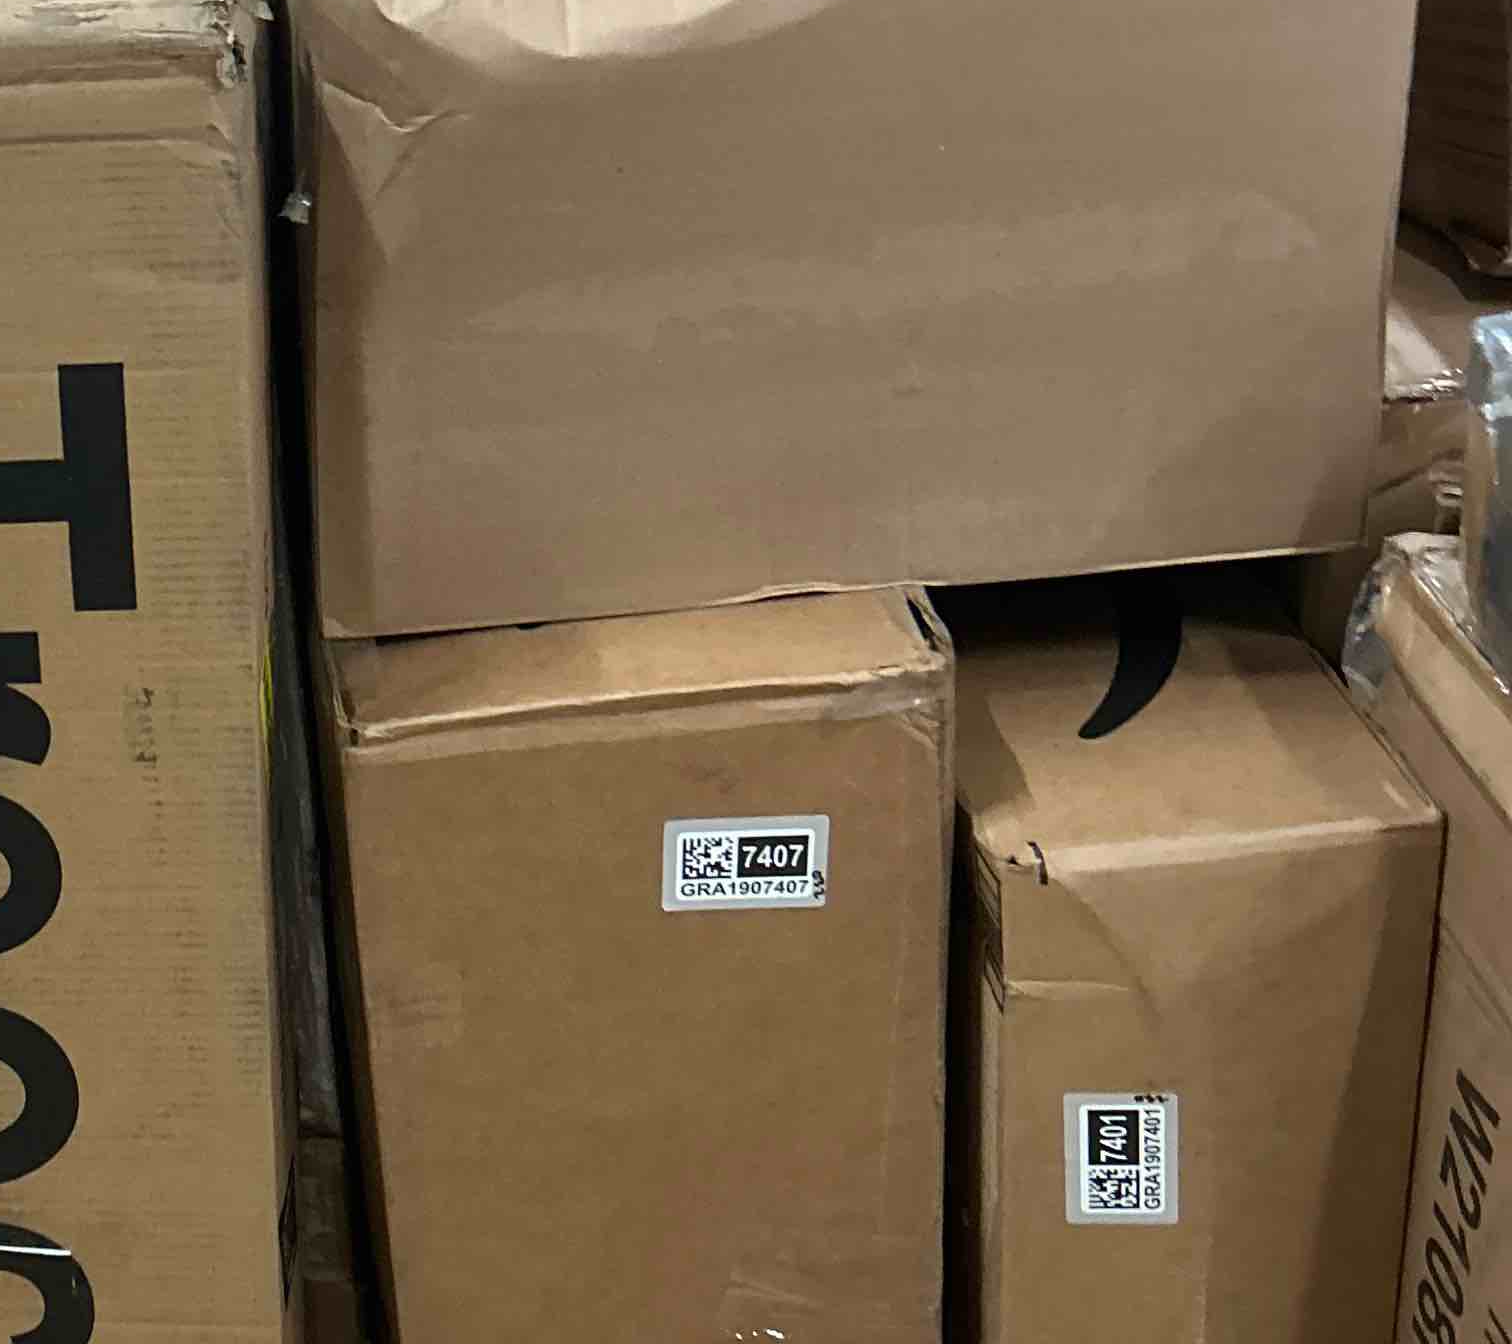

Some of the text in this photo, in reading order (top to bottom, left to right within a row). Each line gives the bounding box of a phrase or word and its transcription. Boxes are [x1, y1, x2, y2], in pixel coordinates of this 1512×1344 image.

[741, 843, 805, 869] 7407
[680, 879, 810, 897] GRA1907407
[1098, 1114, 1129, 1163] 7401
[1143, 1108, 1162, 1210] GRA1907401
